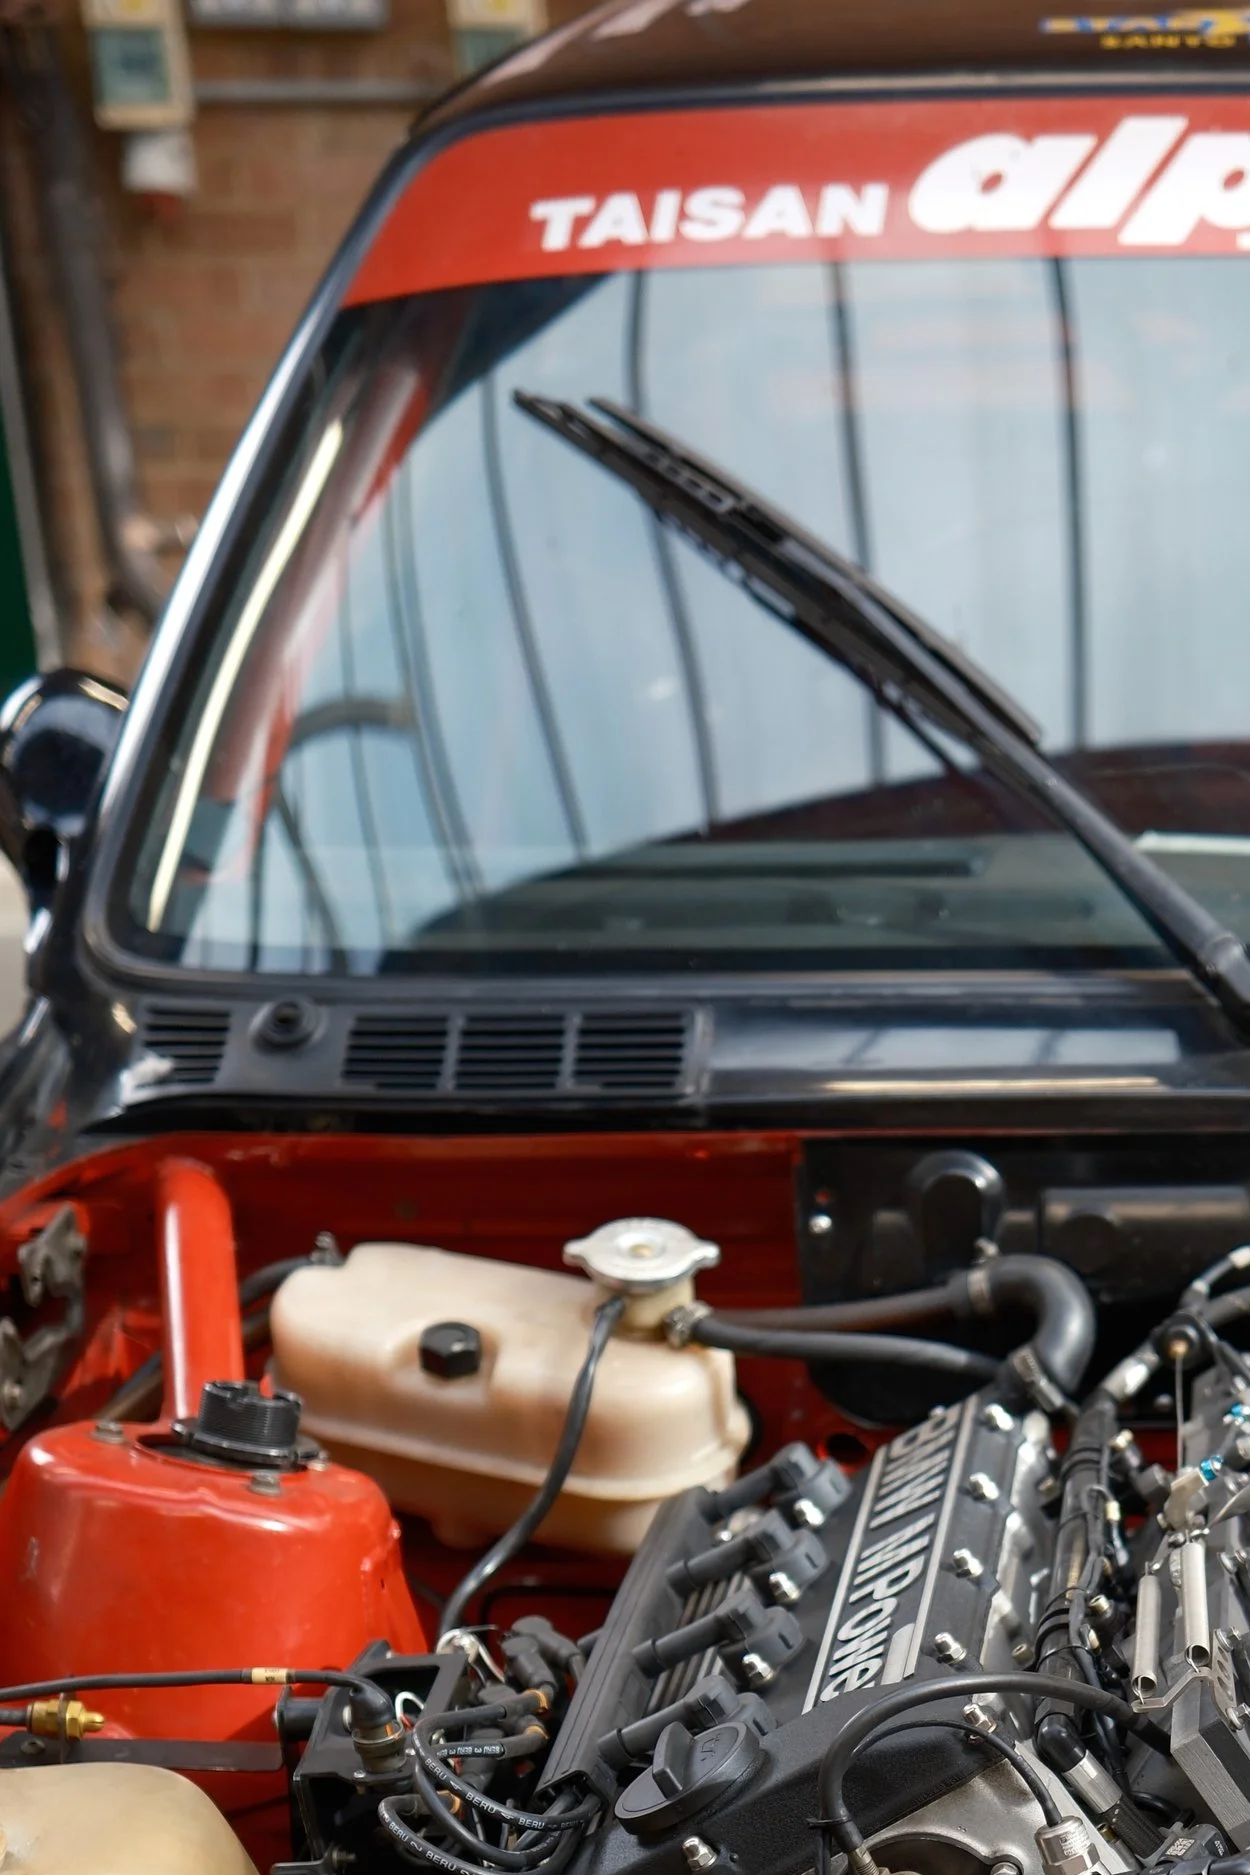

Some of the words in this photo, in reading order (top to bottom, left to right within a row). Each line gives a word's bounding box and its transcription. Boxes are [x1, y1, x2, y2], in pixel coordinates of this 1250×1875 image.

[529, 182, 889, 252] TAISAN
[869, 1403, 961, 1530] BMW
[424, 1757, 448, 1782] BERU
[465, 1791, 497, 1814] BERU
[518, 1817, 546, 1830] BERU
[388, 1821, 410, 1843] BERU
[425, 1851, 457, 1873] BERU
